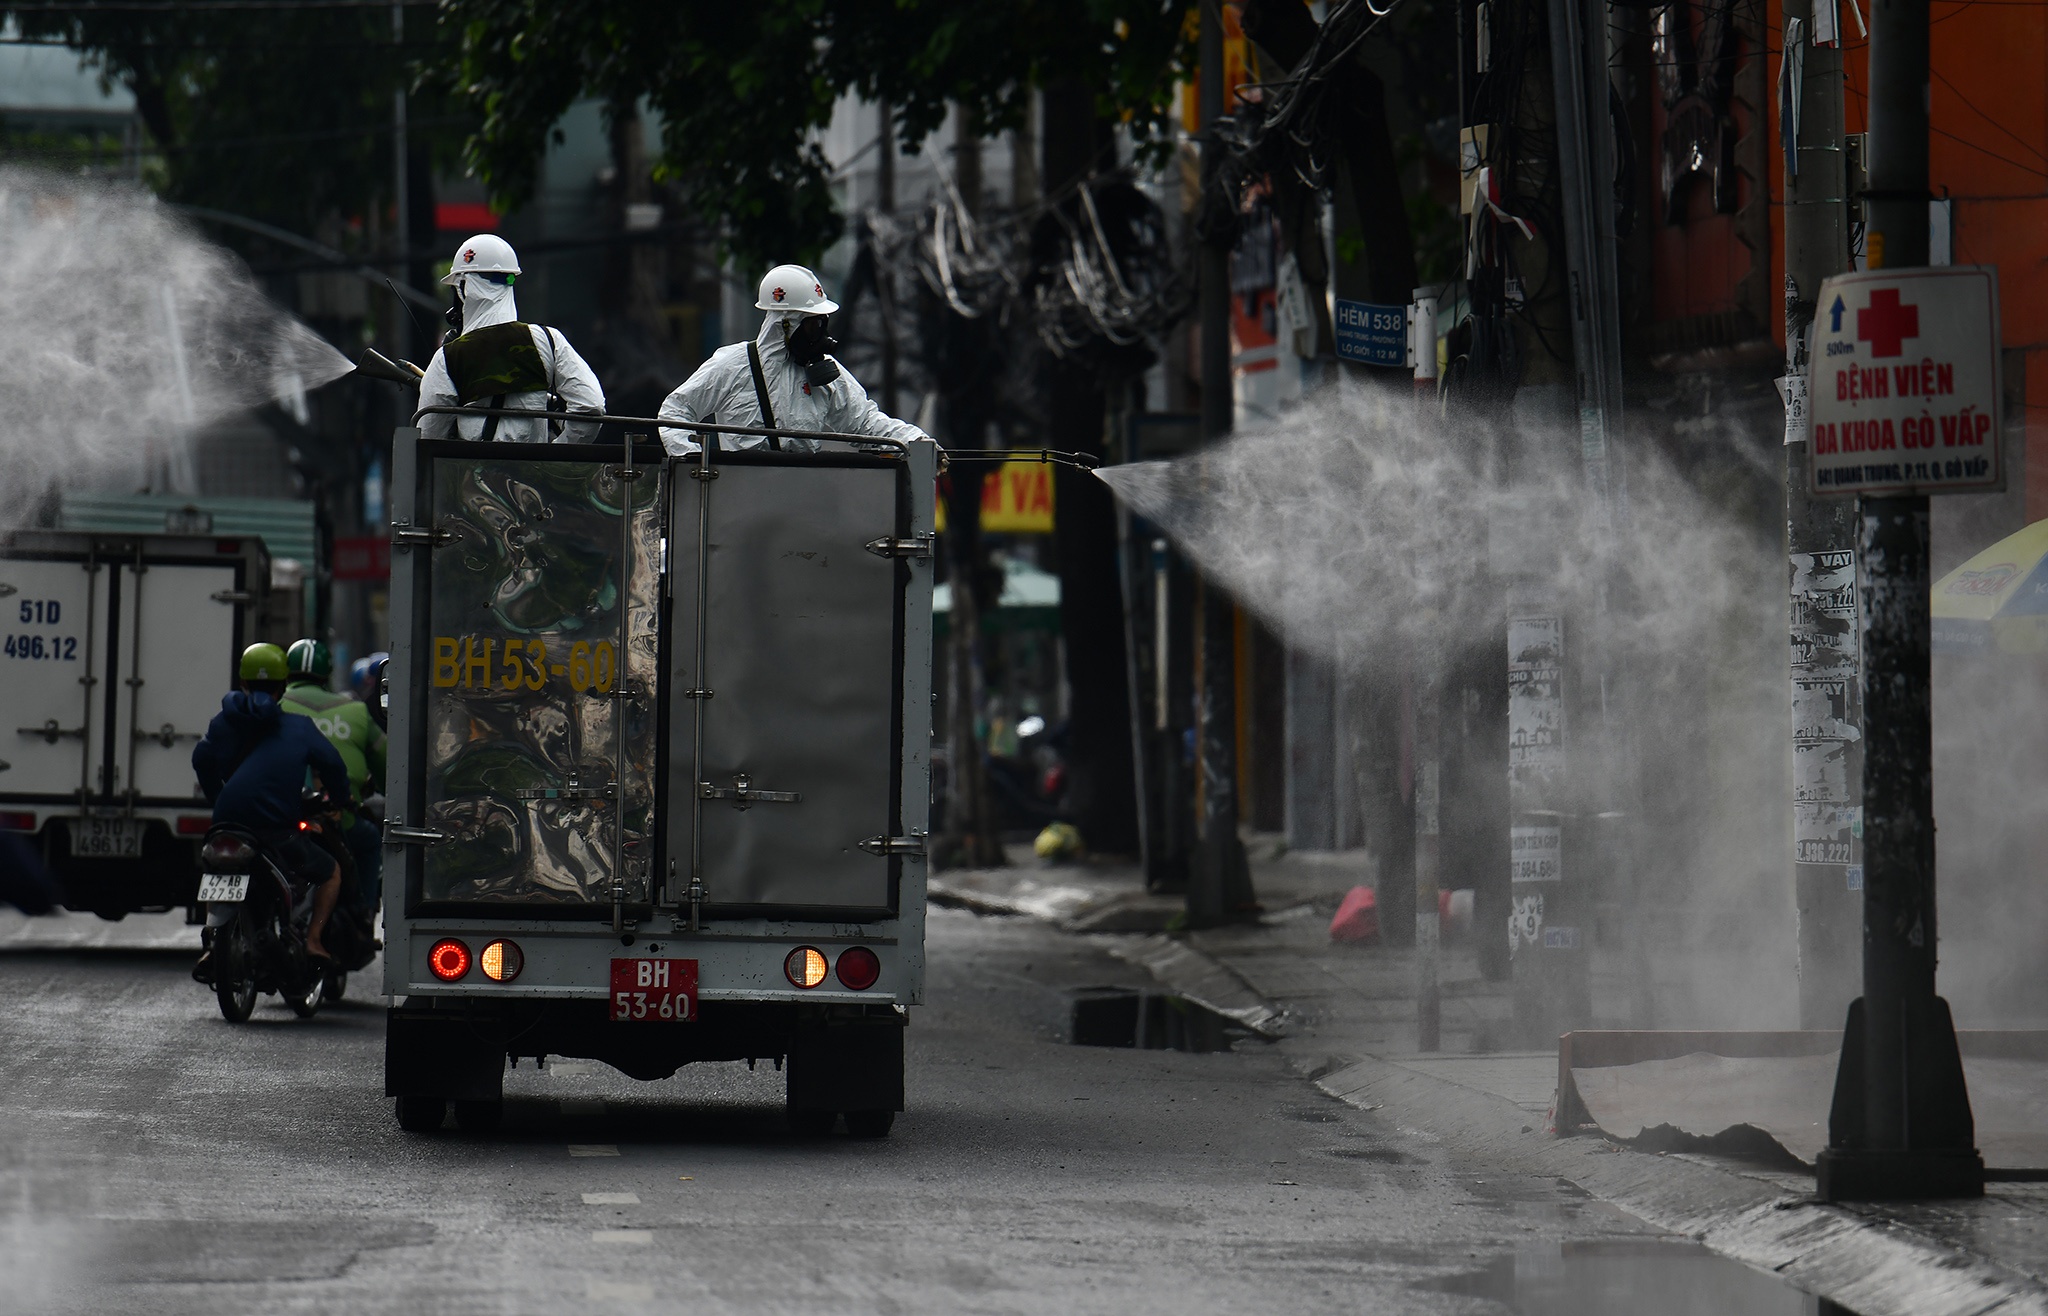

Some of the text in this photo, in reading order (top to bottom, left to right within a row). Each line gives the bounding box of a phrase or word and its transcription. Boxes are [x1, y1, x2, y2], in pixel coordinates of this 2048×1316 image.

[1339, 305, 1402, 331] HẺM 538
[1376, 350, 1386, 359] 12
[1388, 351, 1397, 360] M
[1836, 362, 1889, 407] BỆNH
[1895, 358, 1954, 402] VIỆN
[1841, 418, 1896, 452] KHOA
[1902, 409, 1935, 448] GÒ
[1940, 404, 1991, 448] VẤP
[1834, 465, 1862, 486] QUANG
[1945, 455, 1963, 478] GÒ
[1964, 454, 1989, 477] VẤP
[1820, 553, 1852, 567] VAY
[20, 600, 61, 624] 51D
[5, 635, 77, 661] 496.12
[433, 636, 615, 693] BH 53-60
[1532, 670, 1559, 680] VAY
[92, 819, 123, 836] 51D
[637, 960, 669, 988] BH
[616, 992, 689, 1019] 53-60
